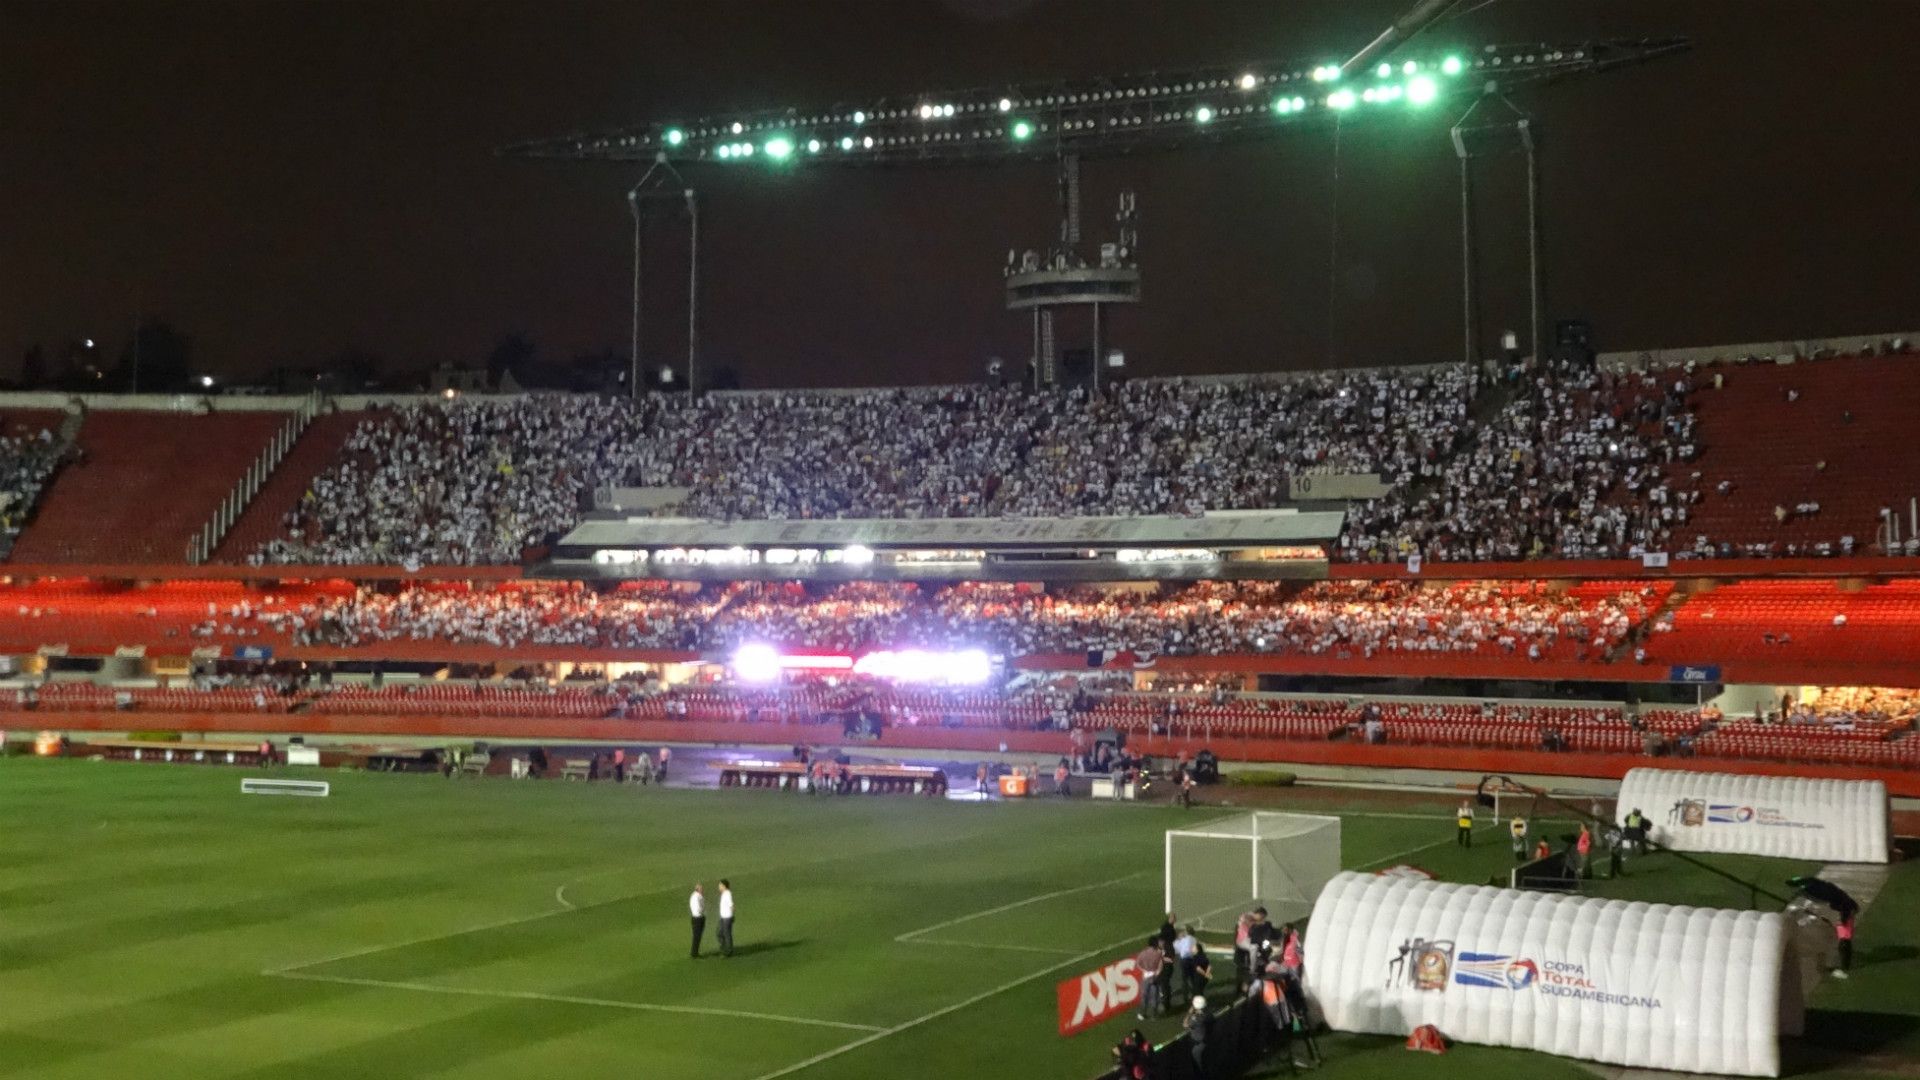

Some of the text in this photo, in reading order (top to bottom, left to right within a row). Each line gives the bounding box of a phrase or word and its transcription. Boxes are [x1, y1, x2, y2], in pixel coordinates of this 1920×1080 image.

[1295, 477, 1311, 493] 10
[1543, 960, 1584, 974] COPA
[1543, 971, 1596, 988] TOTAL
[1541, 984, 1661, 1009] SUDAMERICANA
